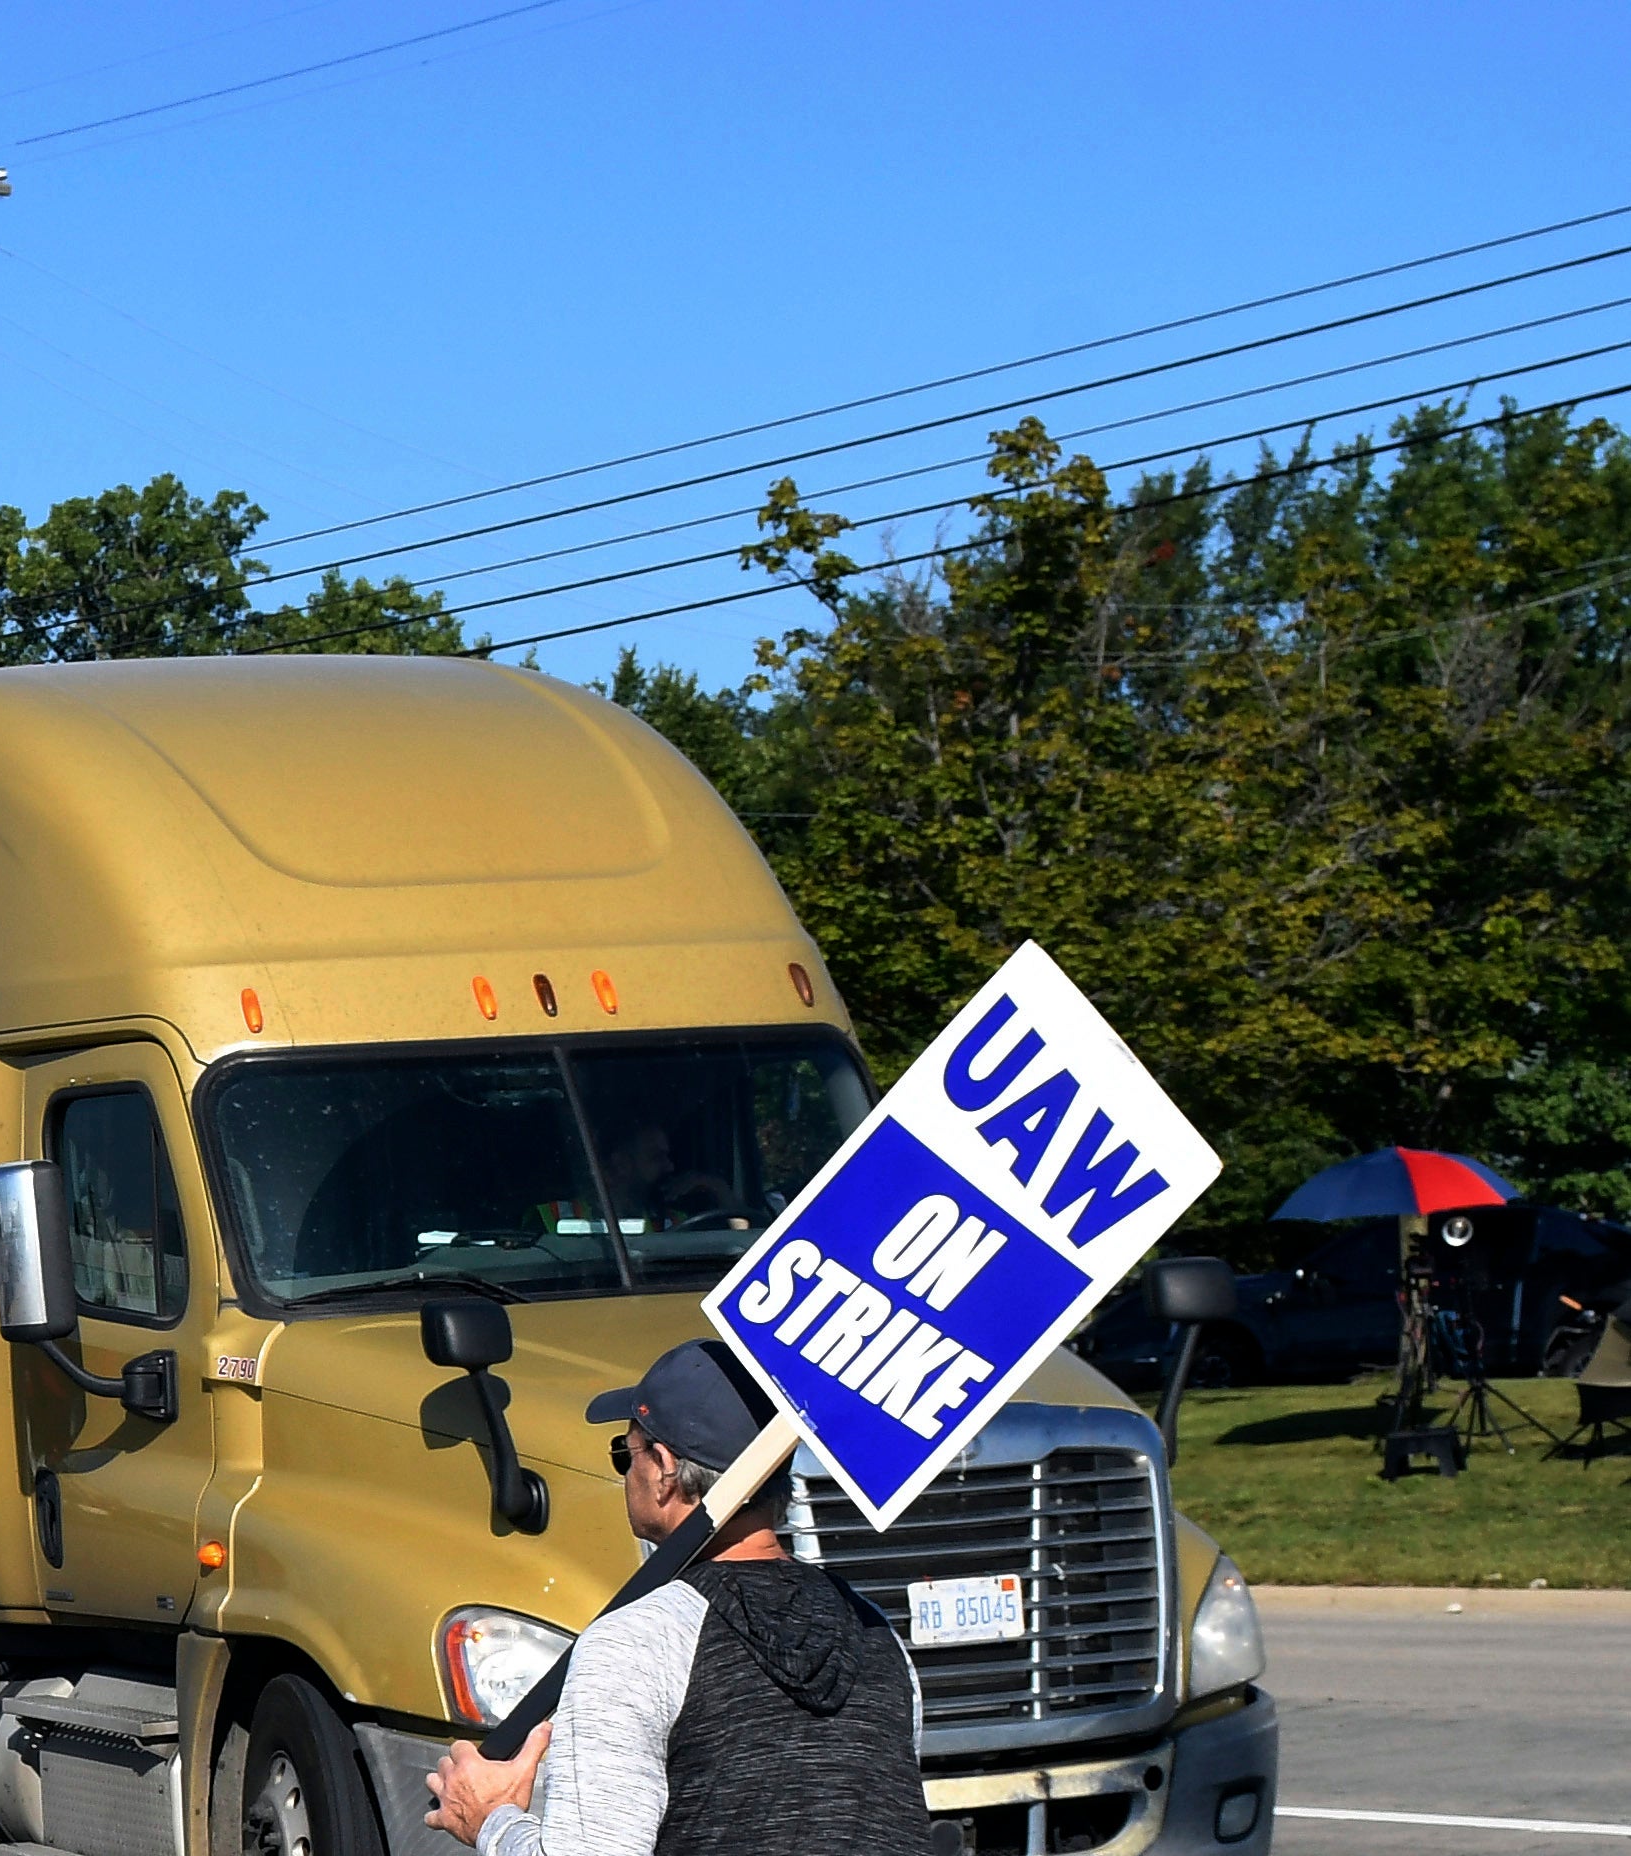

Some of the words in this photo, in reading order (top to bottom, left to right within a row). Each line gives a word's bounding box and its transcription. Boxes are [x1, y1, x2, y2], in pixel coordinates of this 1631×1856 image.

[942, 992, 1170, 1249] UAW
[870, 1193, 1008, 1313] ON
[217, 1355, 257, 1381] 2790
[737, 1238, 995, 1442] STRIKE
[918, 1600, 943, 1630] RB
[955, 1593, 1017, 1627] 85045
